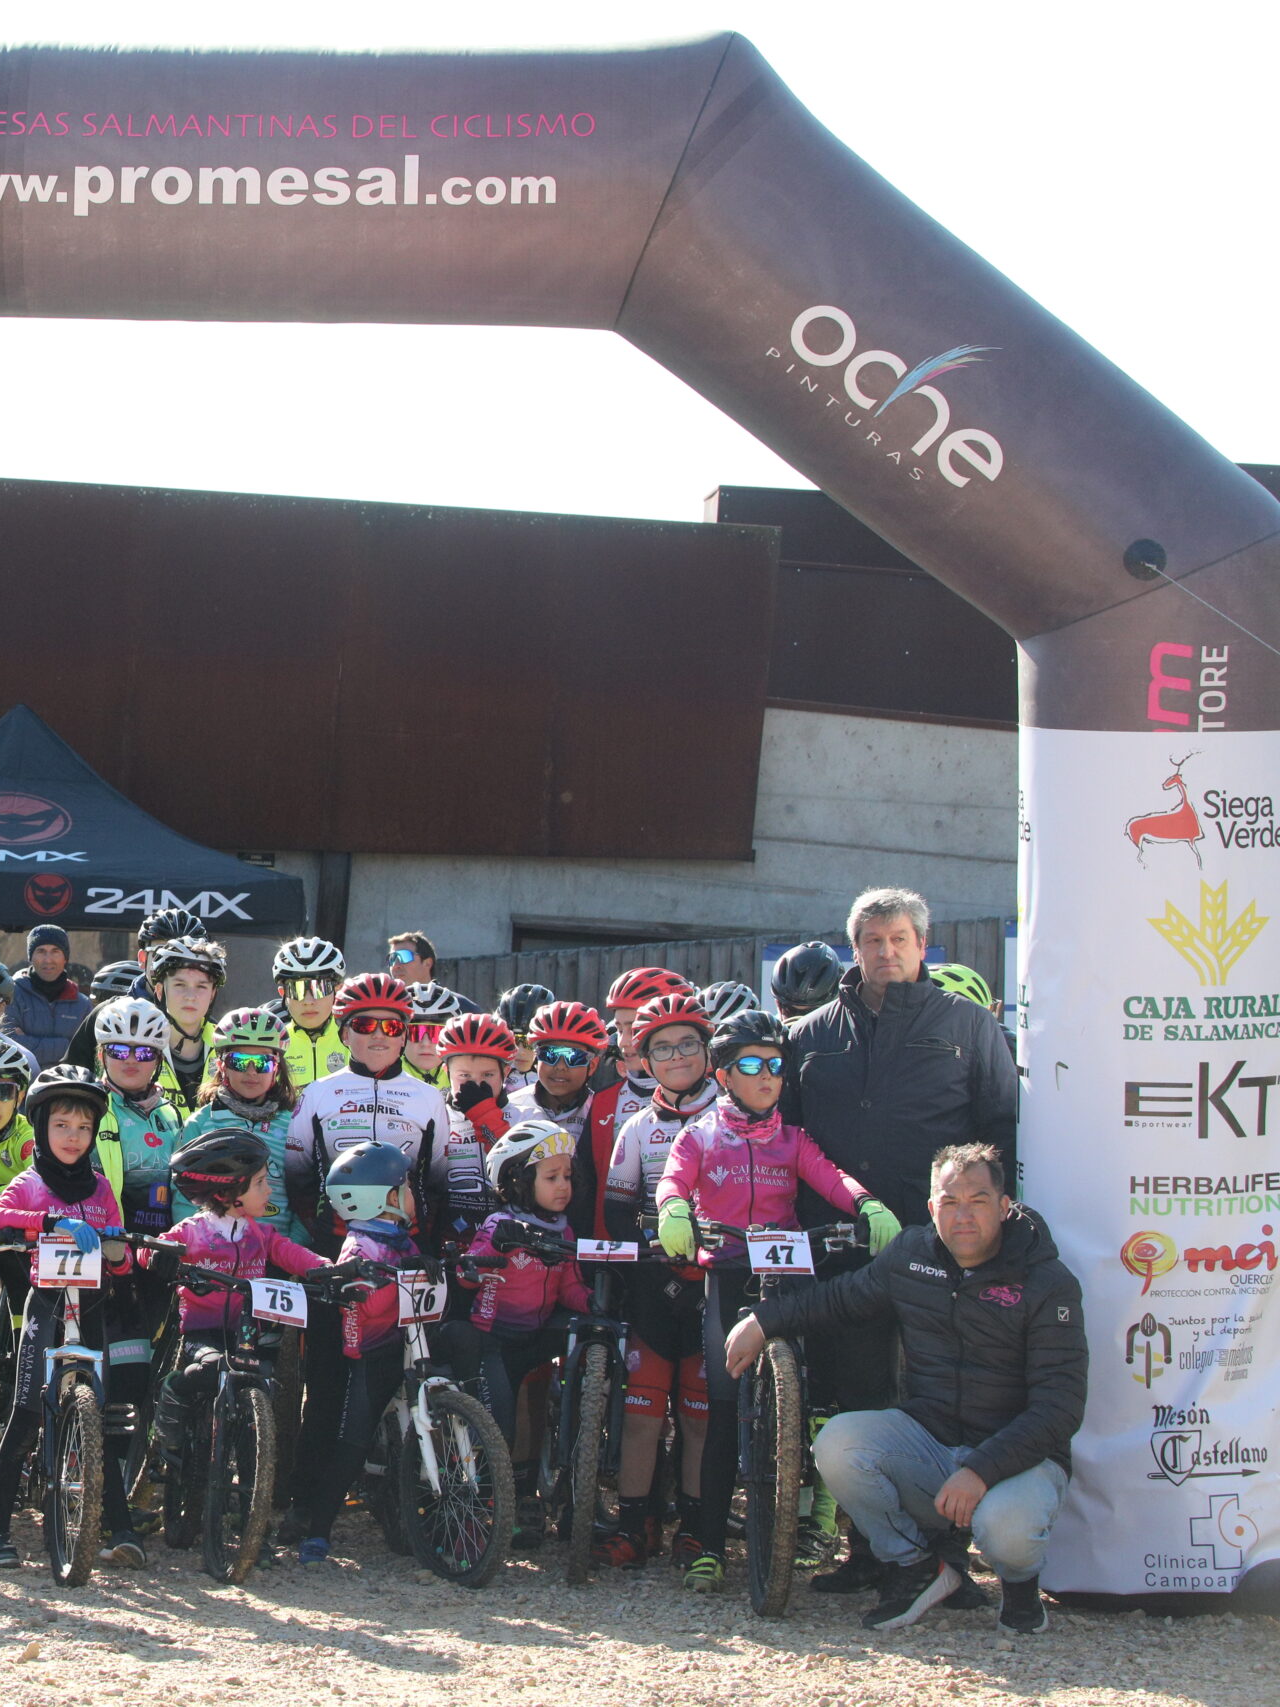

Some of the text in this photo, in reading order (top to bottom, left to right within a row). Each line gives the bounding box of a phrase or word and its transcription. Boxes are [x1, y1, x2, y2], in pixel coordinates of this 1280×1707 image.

[82, 112, 338, 139] SALMANTINAS
[352, 115, 417, 139] DEL
[430, 112, 596, 139] CICLISMO
[766, 346, 925, 481] PINTURAS
[1147, 641, 1194, 732] m
[1203, 789, 1274, 826] Siega
[1215, 820, 1280, 849] Verde
[84, 887, 255, 921] 24MX
[1123, 993, 1280, 1021] CAJA RURAL
[1123, 1024, 1153, 1041] DE
[1124, 1060, 1277, 1140] EKT
[1134, 1120, 1193, 1129] Sportwear
[1130, 1172, 1280, 1195] HERBALIFE
[1130, 1195, 1280, 1217] NUTRITION
[765, 1244, 794, 1265] 47
[1183, 1224, 1279, 1273] mci
[55, 1250, 84, 1276] 77
[265, 1286, 293, 1313] 75
[1152, 1401, 1211, 1429] Mesón
[1160, 1434, 1268, 1475] Castellano
[1144, 1553, 1208, 1569] Clínica
